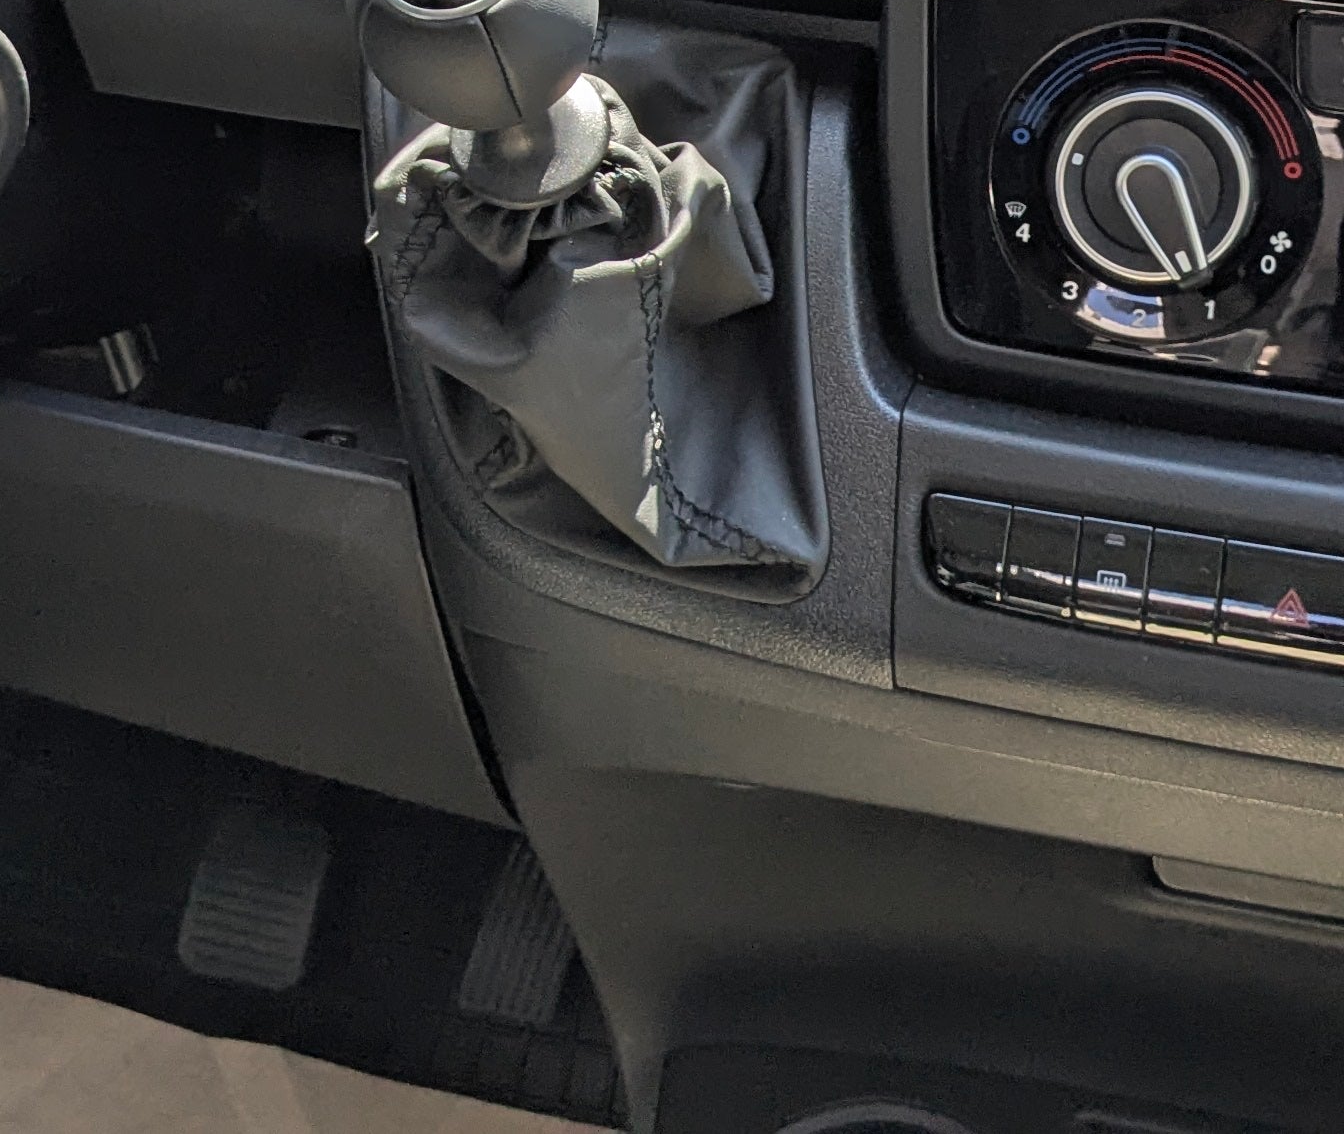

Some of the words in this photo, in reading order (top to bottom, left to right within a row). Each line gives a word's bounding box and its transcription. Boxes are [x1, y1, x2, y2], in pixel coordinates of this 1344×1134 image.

[1015, 223, 1031, 243] 4
[1061, 281, 1079, 301] 3
[1131, 309, 1147, 328] 2
[1205, 300, 1216, 320] 1
